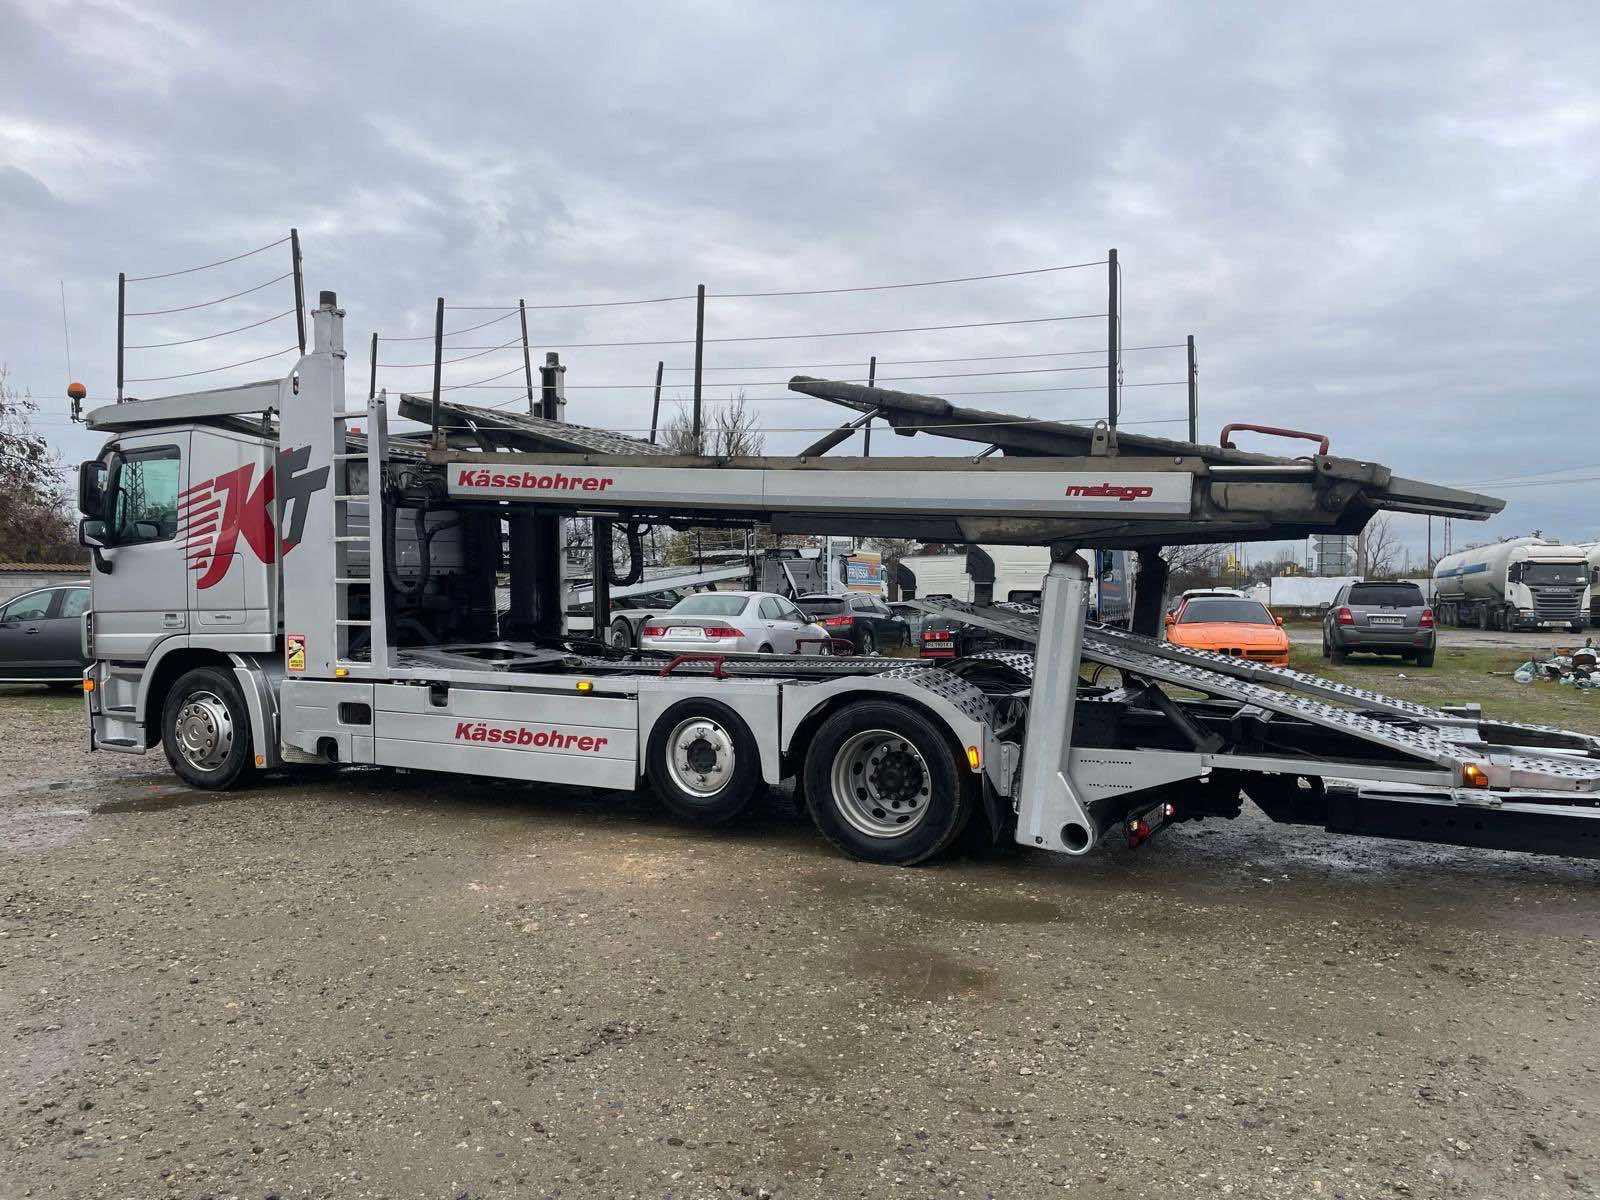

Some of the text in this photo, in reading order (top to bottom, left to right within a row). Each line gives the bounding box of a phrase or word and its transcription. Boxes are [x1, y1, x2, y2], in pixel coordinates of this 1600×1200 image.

[457, 469, 614, 492] Kässbohrer
[1064, 482, 1154, 502] metago
[454, 722, 609, 752] Kässbohrer
